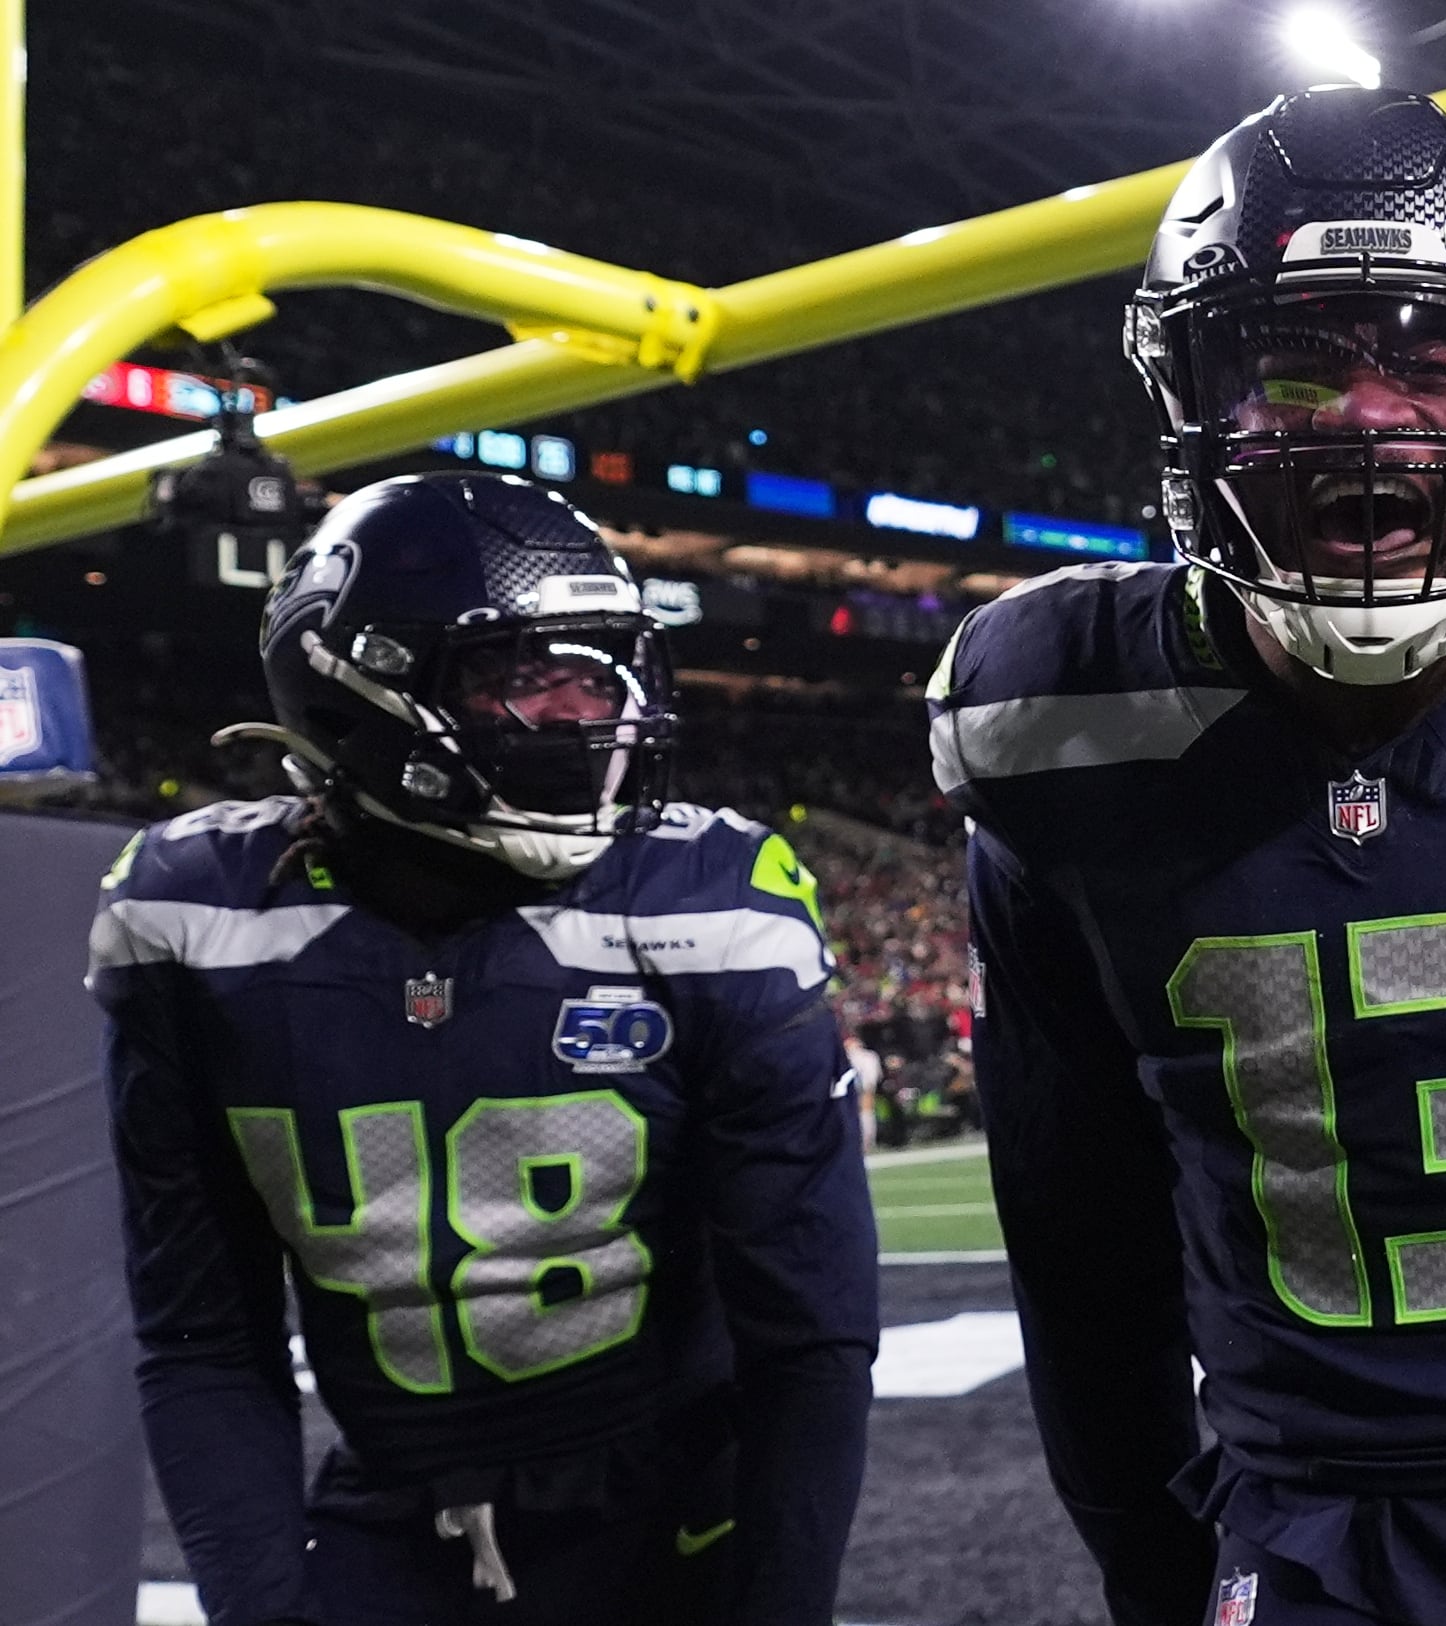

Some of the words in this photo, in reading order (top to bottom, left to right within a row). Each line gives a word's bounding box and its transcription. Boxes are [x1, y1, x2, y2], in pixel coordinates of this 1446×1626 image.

[1321, 228, 1412, 254] SEAHAWKS
[1337, 804, 1377, 831] NFL
[554, 1000, 673, 1063] 50
[226, 1088, 655, 1395] 48
